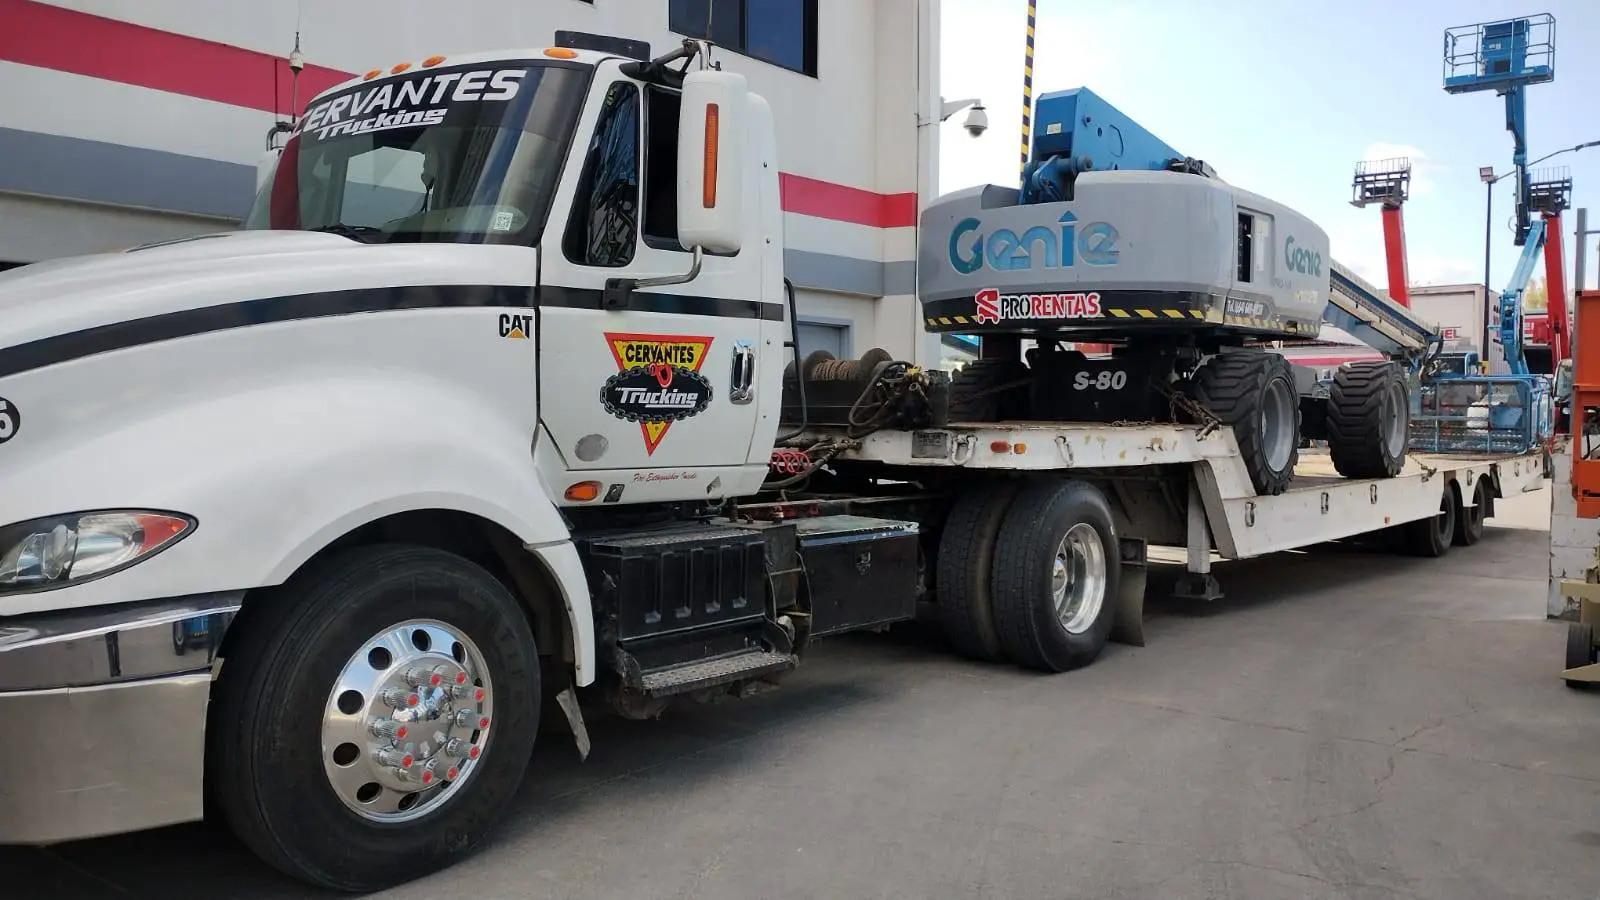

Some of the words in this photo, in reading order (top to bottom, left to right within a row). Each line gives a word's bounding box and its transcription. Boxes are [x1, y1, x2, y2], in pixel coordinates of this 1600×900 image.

[290, 69, 527, 138] CERVANTES
[312, 108, 448, 141] Trucking
[949, 209, 1121, 276] Genie
[1285, 234, 1322, 278] Genie
[1001, 293, 1099, 318] PRORENTAS
[499, 313, 533, 339] CAT
[625, 344, 694, 364] CERVANTES
[1073, 370, 1127, 391] S-80
[615, 387, 698, 408] Trucking
